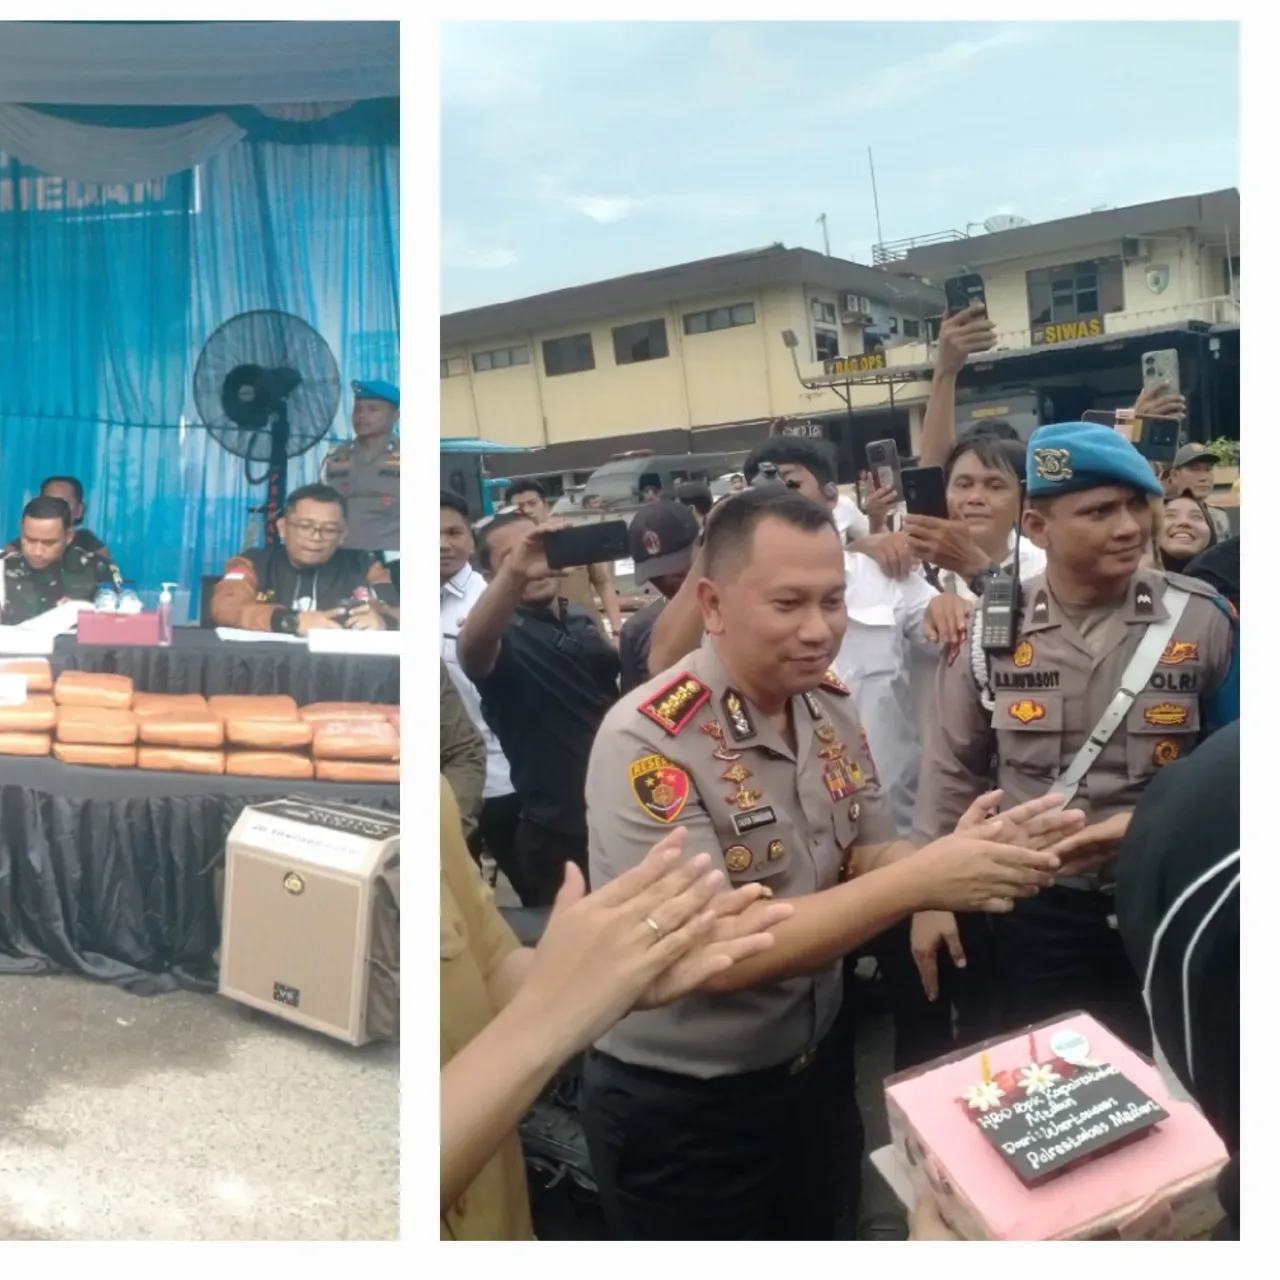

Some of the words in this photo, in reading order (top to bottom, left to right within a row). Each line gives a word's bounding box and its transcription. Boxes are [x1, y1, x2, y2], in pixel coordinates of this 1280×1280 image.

[1045, 318, 1101, 343] SIWAS
[861, 353, 883, 371] OPS
[1150, 671, 1197, 690] OLRI
[977, 1107, 1013, 1130] HBD
[1025, 1096, 1078, 1127] Medan
[1041, 1096, 1119, 1140] Wartawan
[1026, 1120, 1110, 1170] Polrestabes
[1108, 1099, 1161, 1128] Medan
